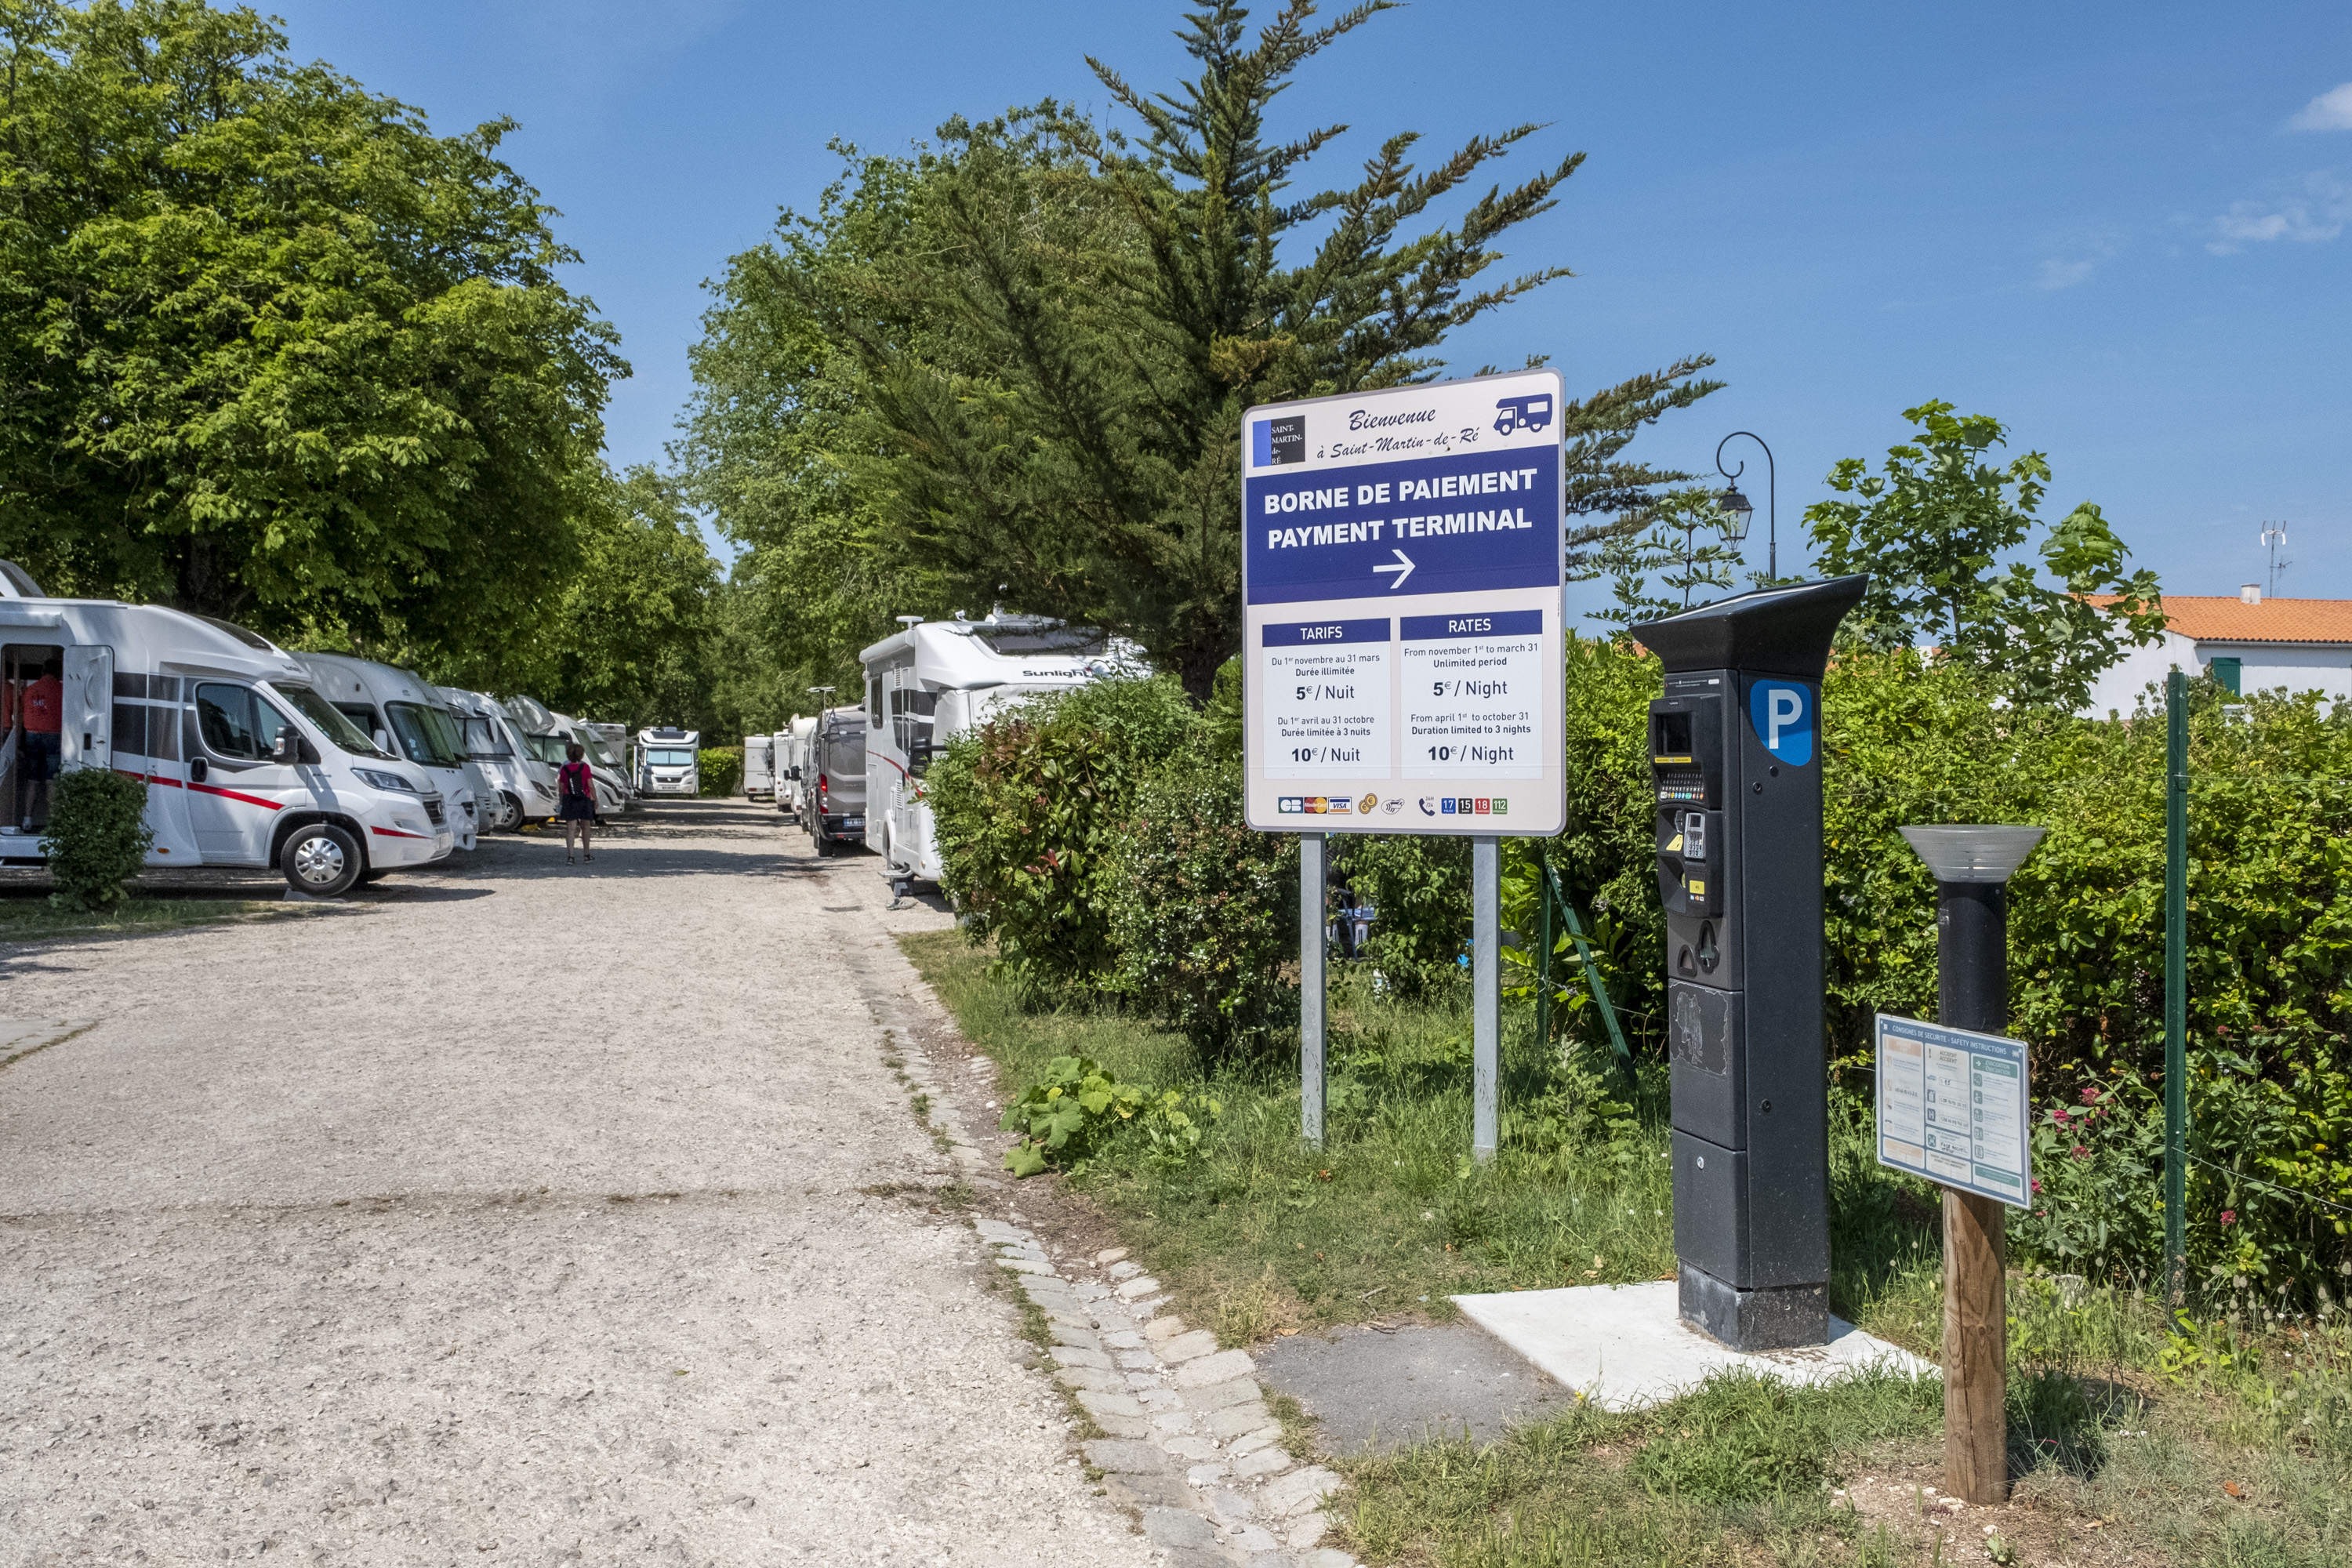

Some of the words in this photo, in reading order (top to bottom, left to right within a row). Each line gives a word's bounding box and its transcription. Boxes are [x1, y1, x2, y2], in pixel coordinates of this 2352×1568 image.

[1348, 408, 1436, 430] Bienvenue
[1271, 424, 1294, 434] SAINT-
[1271, 434, 1303, 444] MARTIN-
[1316, 445, 1325, 459] à
[1272, 455, 1282, 465] RÉ
[1265, 487, 1349, 514] BORNE
[1357, 483, 1391, 506] DE
[1399, 468, 1537, 502] PAIEMENT
[1269, 520, 1385, 550] PAYMENT
[1392, 508, 1533, 539] TERMINAL
[1448, 618, 1492, 633] RATES
[1300, 626, 1343, 641] TARIFS
[1404, 648, 1426, 657] From
[1428, 646, 1472, 655] november
[1497, 643, 1526, 653] march
[1272, 657, 1283, 666] Du
[1294, 655, 1334, 665] novembre
[1347, 654, 1356, 662] 31
[1433, 658, 1476, 668] Unlimited
[1478, 657, 1507, 668] period
[1022, 670, 1091, 678] Sunlight
[1295, 666, 1319, 677] Durée
[1321, 666, 1355, 676] illimitée
[1325, 684, 1355, 699] Nuit
[1465, 680, 1508, 699] Night
[1277, 717, 1288, 725] Du
[1344, 715, 1374, 724] octobre
[1410, 713, 1432, 722] From
[1435, 713, 1455, 724] april
[1483, 712, 1516, 721] october
[1519, 712, 1529, 720] 31
[1769, 688, 1803, 750] P
[1281, 728, 1305, 737] Durée
[1307, 728, 1334, 737] limitée
[1336, 728, 1341, 736] à
[1343, 728, 1348, 736] 3
[1350, 728, 1370, 736] nuits
[1411, 726, 1449, 735] Duration
[1451, 725, 1482, 735] limited
[1484, 725, 1493, 734] to
[1495, 725, 1501, 734] 3
[1503, 724, 1531, 735] nights
[1331, 747, 1360, 762] Nuit
[1472, 746, 1514, 764] Night
[1443, 800, 1454, 809] 17
[1460, 800, 1471, 809] 15
[1477, 800, 1488, 809] 18
[1494, 800, 1506, 810] 112
[1892, 1025, 1918, 1037] CONSIGNES
[1924, 1031, 1947, 1043] SECURITE
[1951, 1037, 1969, 1047] SAFETY
[1969, 1041, 2007, 1055] INSTRUCTIONS
[1939, 1050, 1958, 1058] ACCIDENT
[1939, 1055, 1958, 1064] ACCIDENT
